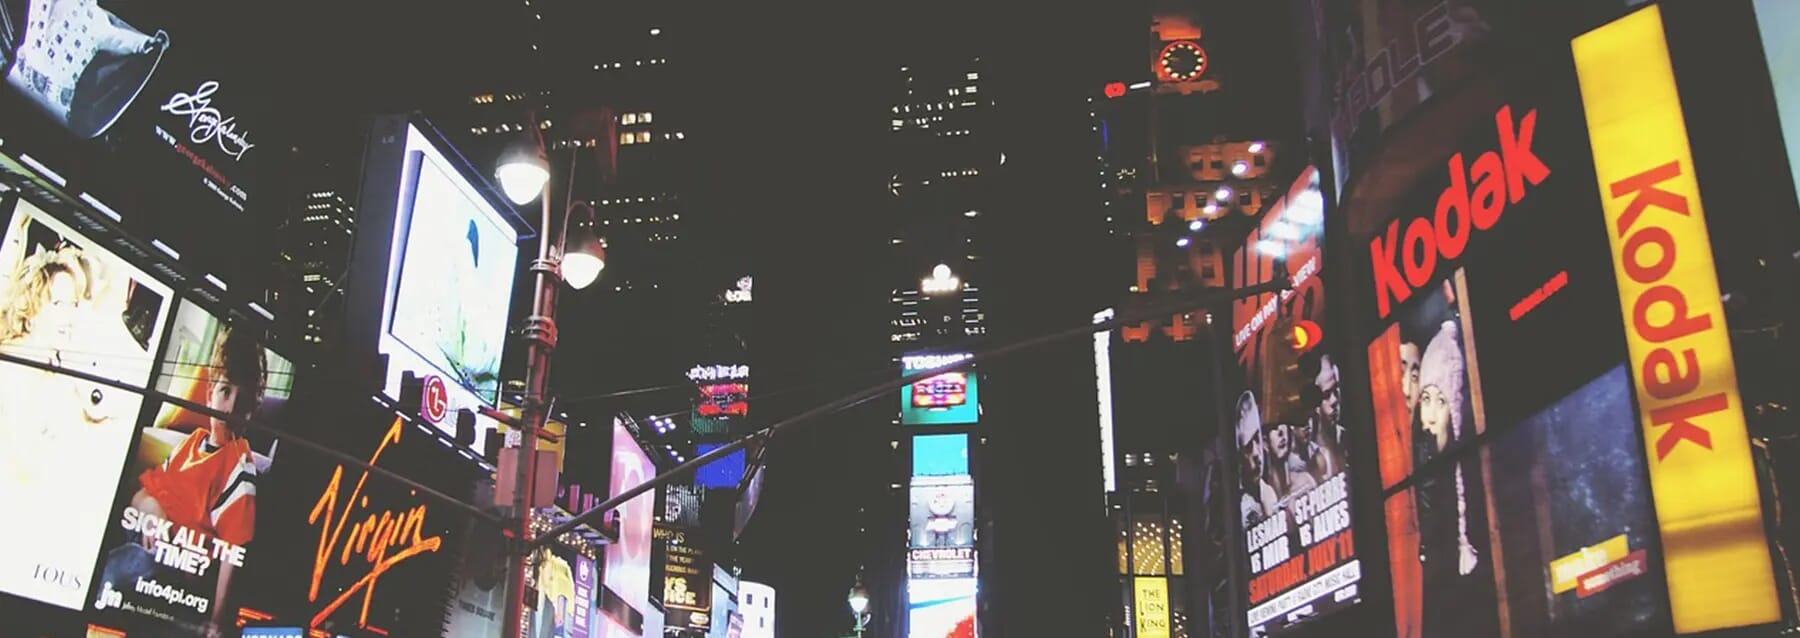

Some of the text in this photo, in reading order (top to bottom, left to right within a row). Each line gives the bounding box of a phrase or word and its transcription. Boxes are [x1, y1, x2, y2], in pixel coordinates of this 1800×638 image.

[1369, 104, 1552, 319] Kodak
[1609, 159, 1729, 463] Kodak
[121, 506, 247, 567] SICK ALL THE
[308, 415, 442, 630] Virgin
[1247, 510, 1288, 553] LESNAR
[1313, 500, 1350, 543] ALVES
[154, 540, 211, 576] TIME?
[911, 548, 972, 560] CHEVROLET
[1262, 545, 1290, 570] MIR
[1307, 537, 1337, 577] JULY
[33, 563, 82, 591] TOUS
[135, 576, 209, 613] info4pi.org
[1142, 588, 1160, 599] THE
[1139, 600, 1164, 616] LION
[1140, 617, 1166, 633] KING
